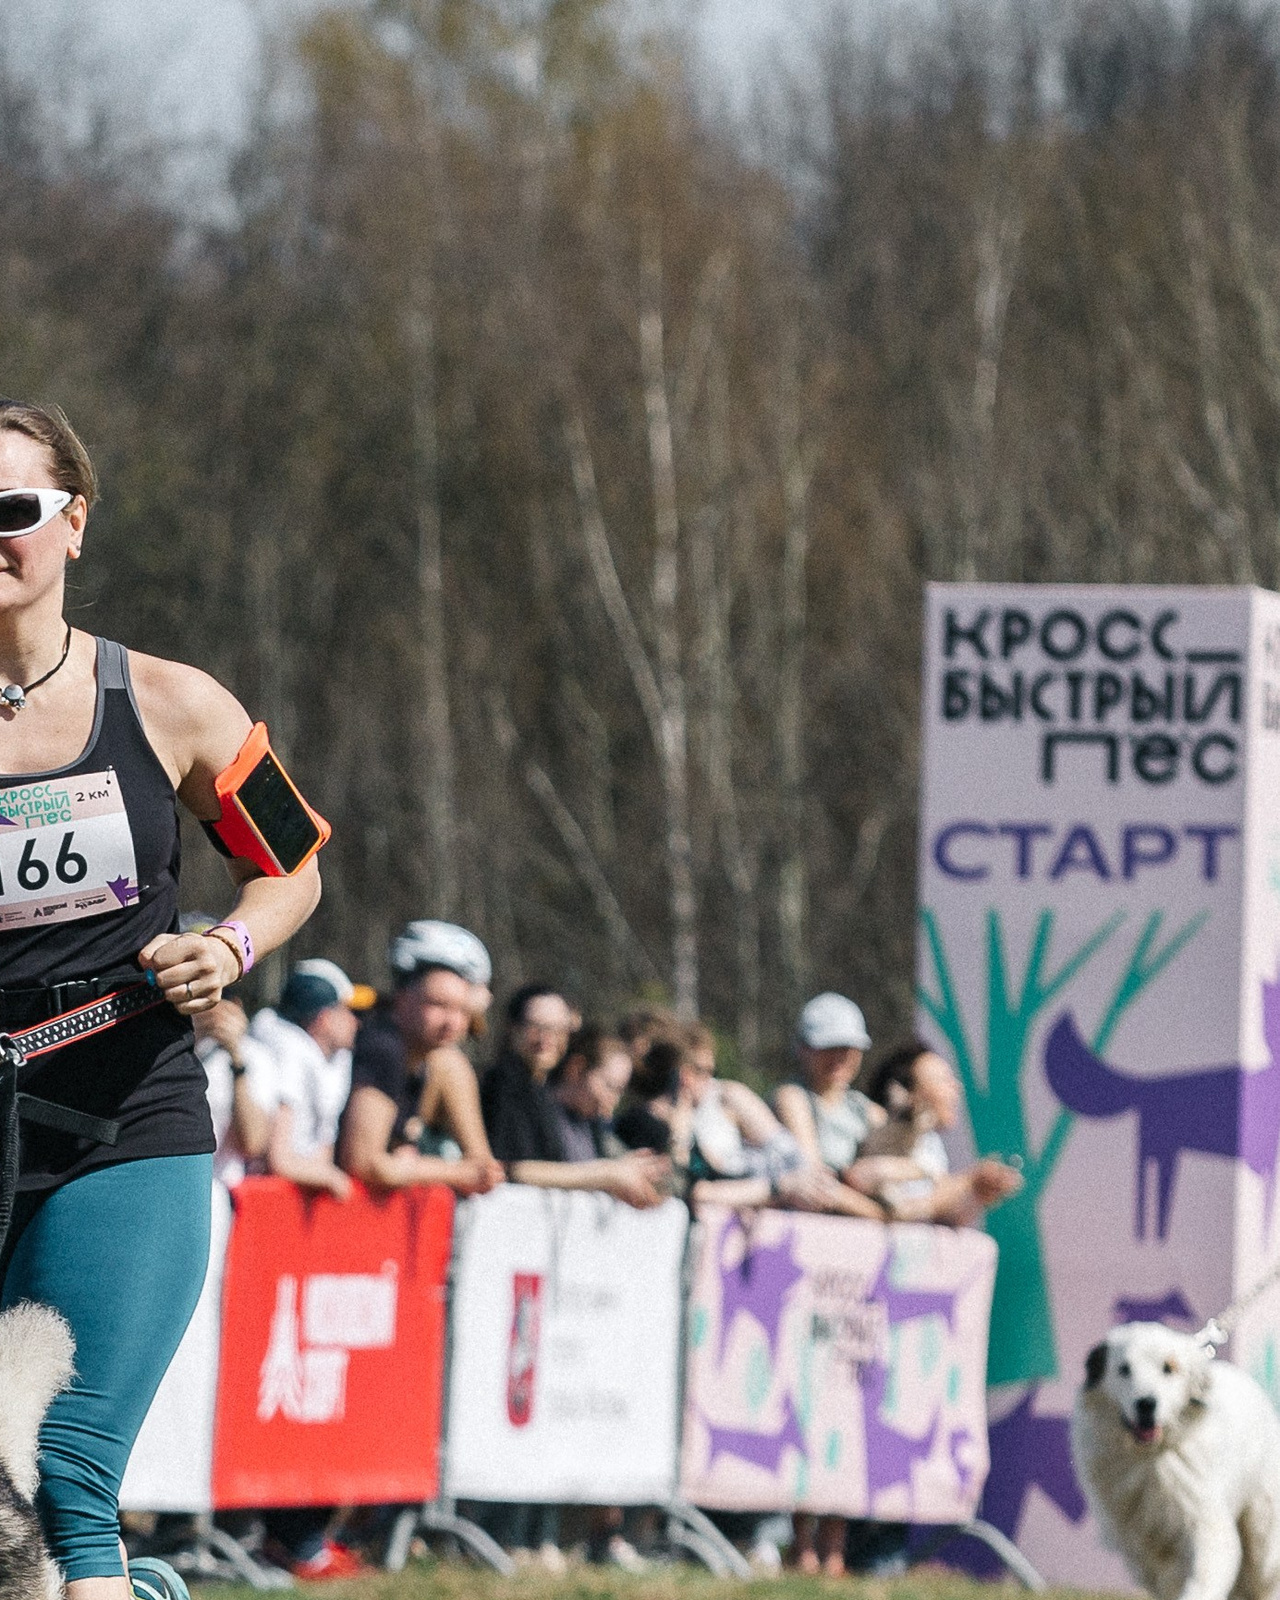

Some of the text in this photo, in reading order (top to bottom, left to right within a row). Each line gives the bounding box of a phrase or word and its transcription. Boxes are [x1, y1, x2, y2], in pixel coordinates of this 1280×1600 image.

[943, 607, 1179, 662] КРОСС
[75, 792, 86, 803] 2
[932, 821, 1240, 882] СТАРТ
